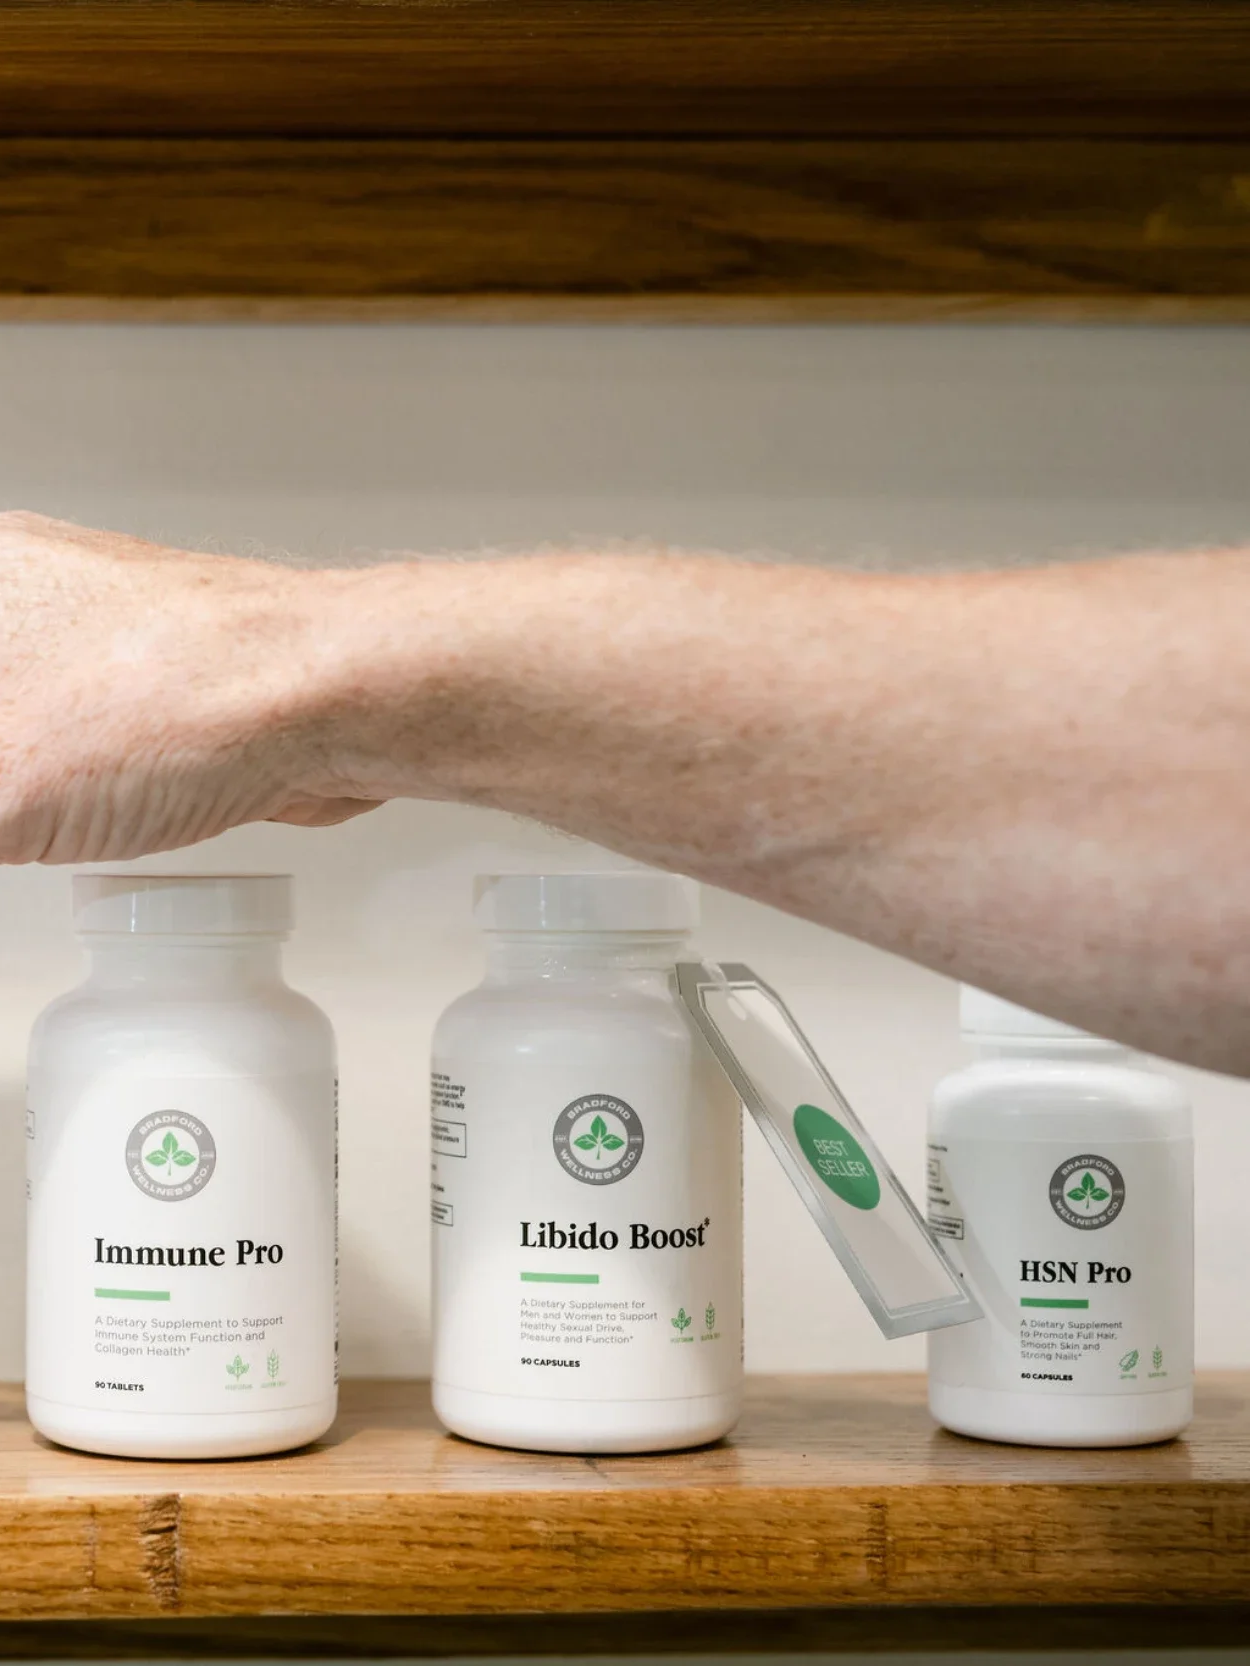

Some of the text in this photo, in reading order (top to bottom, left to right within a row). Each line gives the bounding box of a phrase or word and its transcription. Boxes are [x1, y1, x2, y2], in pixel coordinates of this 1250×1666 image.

[567, 1099, 631, 1120] BRADFORD
[138, 1115, 203, 1136] BRADFORD
[813, 1139, 848, 1156] BEST
[560, 1148, 621, 1180] WELLNESS
[817, 1159, 869, 1177] SELLER
[1060, 1158, 1115, 1177] BRADFORD
[132, 1164, 193, 1196] WELLNESS
[1055, 1200, 1107, 1226] WELLNESS
[520, 1221, 618, 1250] Libido
[95, 1238, 283, 1266] Immune Pro
[1020, 1260, 1131, 1283] HSN Pro
[521, 1299, 646, 1312] A Dietary Supplement for
[95, 1315, 283, 1330] A Dietary Supplement to Support
[521, 1310, 657, 1323] Men and Women to Support
[521, 1321, 624, 1334] Healthy Sexual Drive,
[1021, 1319, 1123, 1331] A Dietary Supplement
[95, 1330, 265, 1344] Immune System Function and
[521, 1333, 561, 1343] Pleasure
[565, 1334, 583, 1344] and
[1021, 1330, 1117, 1341] to Promote Full Hair,
[95, 1344, 142, 1358] Collagen
[1021, 1341, 1100, 1350] Smooth Skin and
[521, 1358, 580, 1367] 90 CAPSULES
[1021, 1351, 1052, 1361] Strong
[1033, 1373, 1073, 1381] CAPSULES
[95, 1381, 144, 1391] 90 TABLETS
